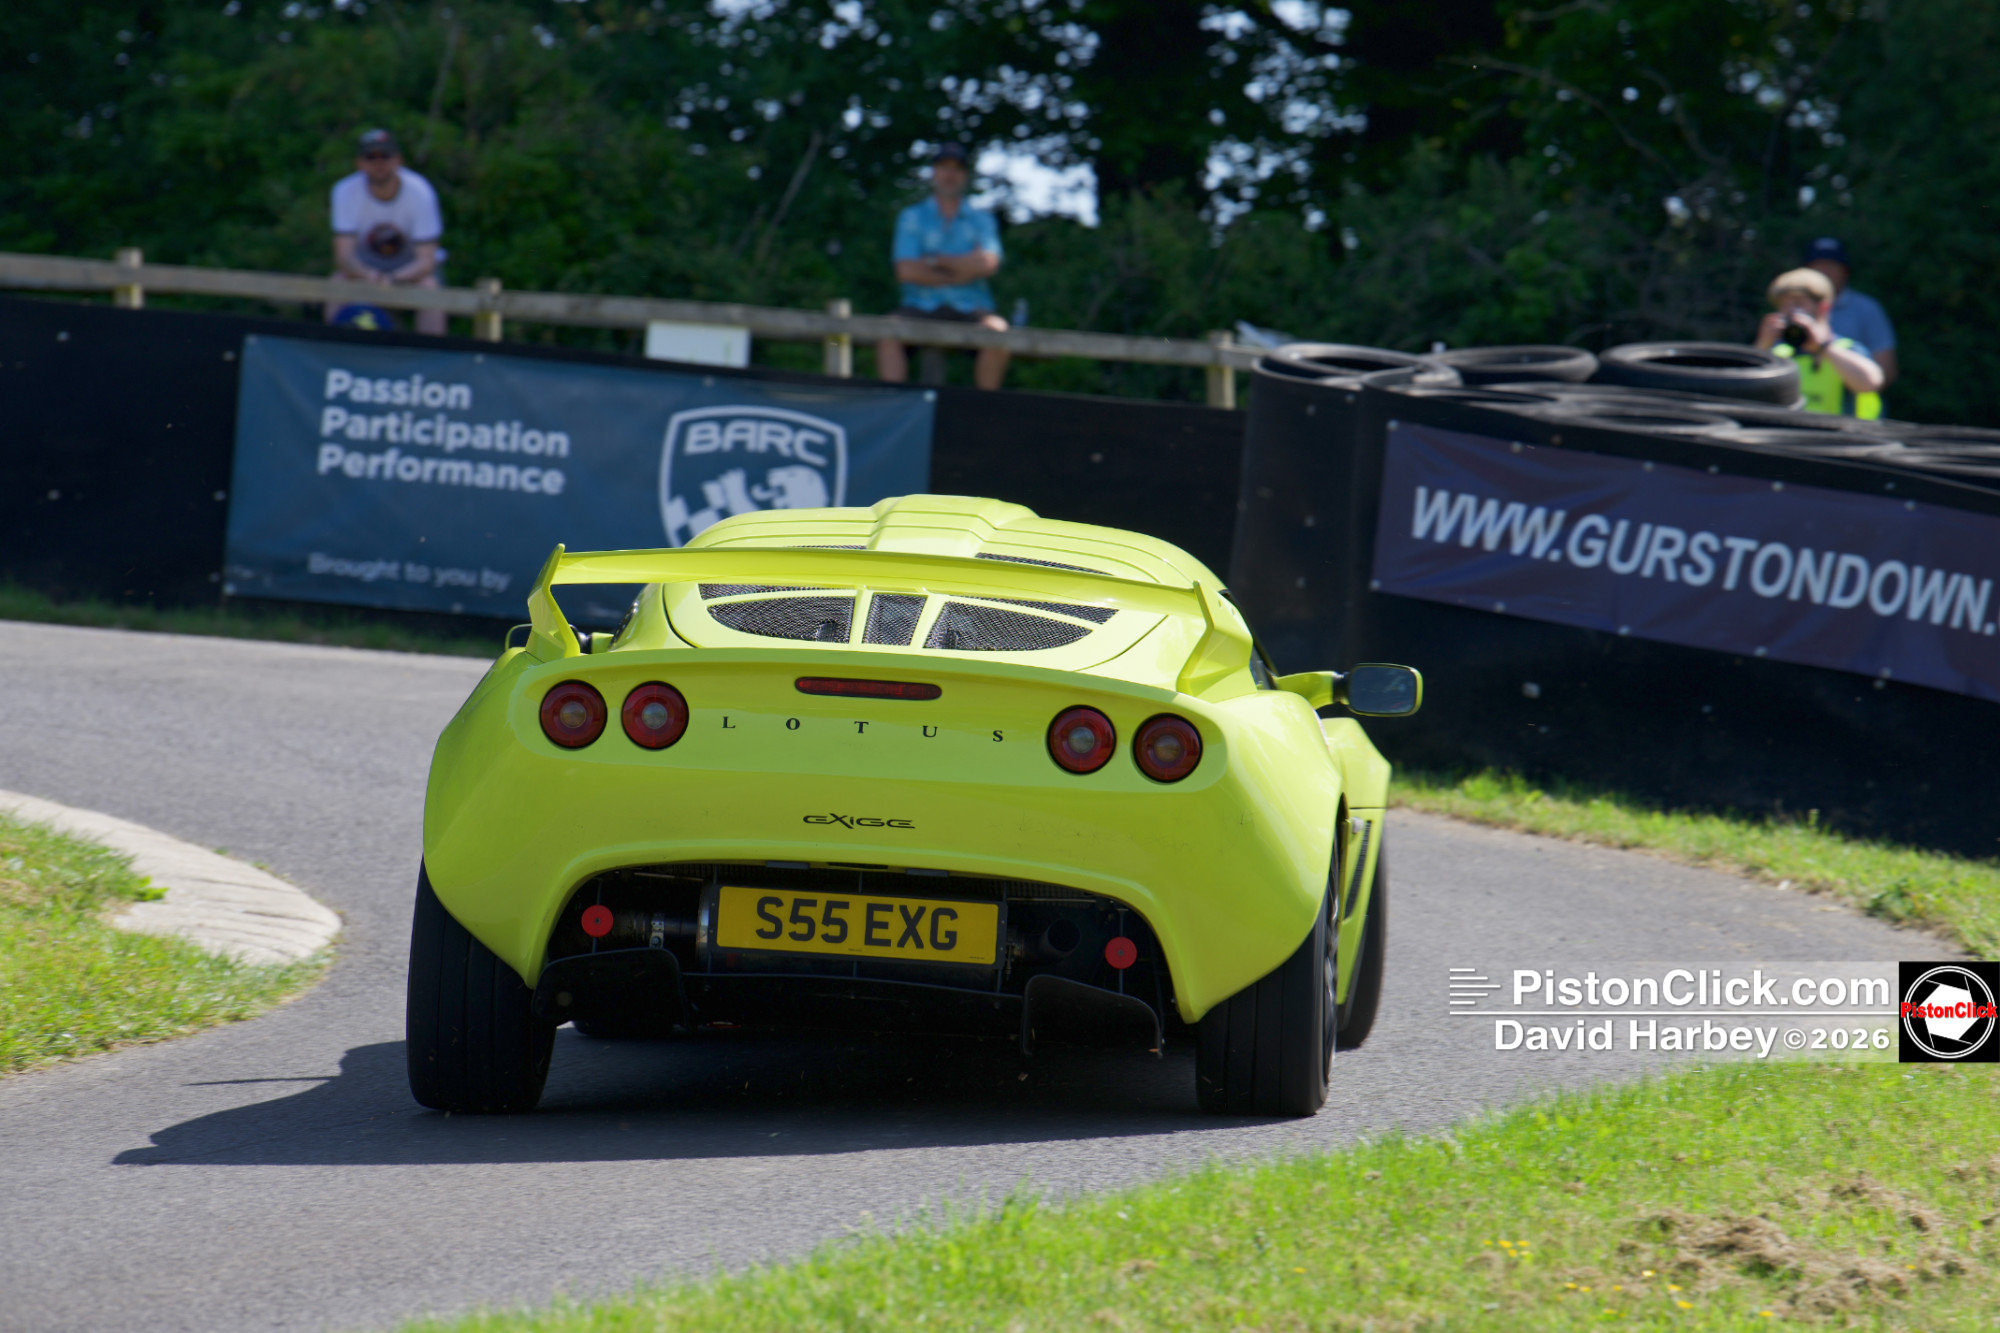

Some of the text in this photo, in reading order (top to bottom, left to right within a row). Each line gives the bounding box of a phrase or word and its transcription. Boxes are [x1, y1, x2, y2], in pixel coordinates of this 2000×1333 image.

[325, 368, 472, 409] Passion
[320, 406, 569, 457] Participation
[684, 420, 828, 466] BARC
[317, 443, 565, 495] Performance
[308, 552, 512, 593] Brought to you by
[1412, 486, 2000, 636] WWW.GURSTONDOWN.
[722, 716, 1004, 742] LOTUS
[756, 896, 958, 950] S55 EXG
